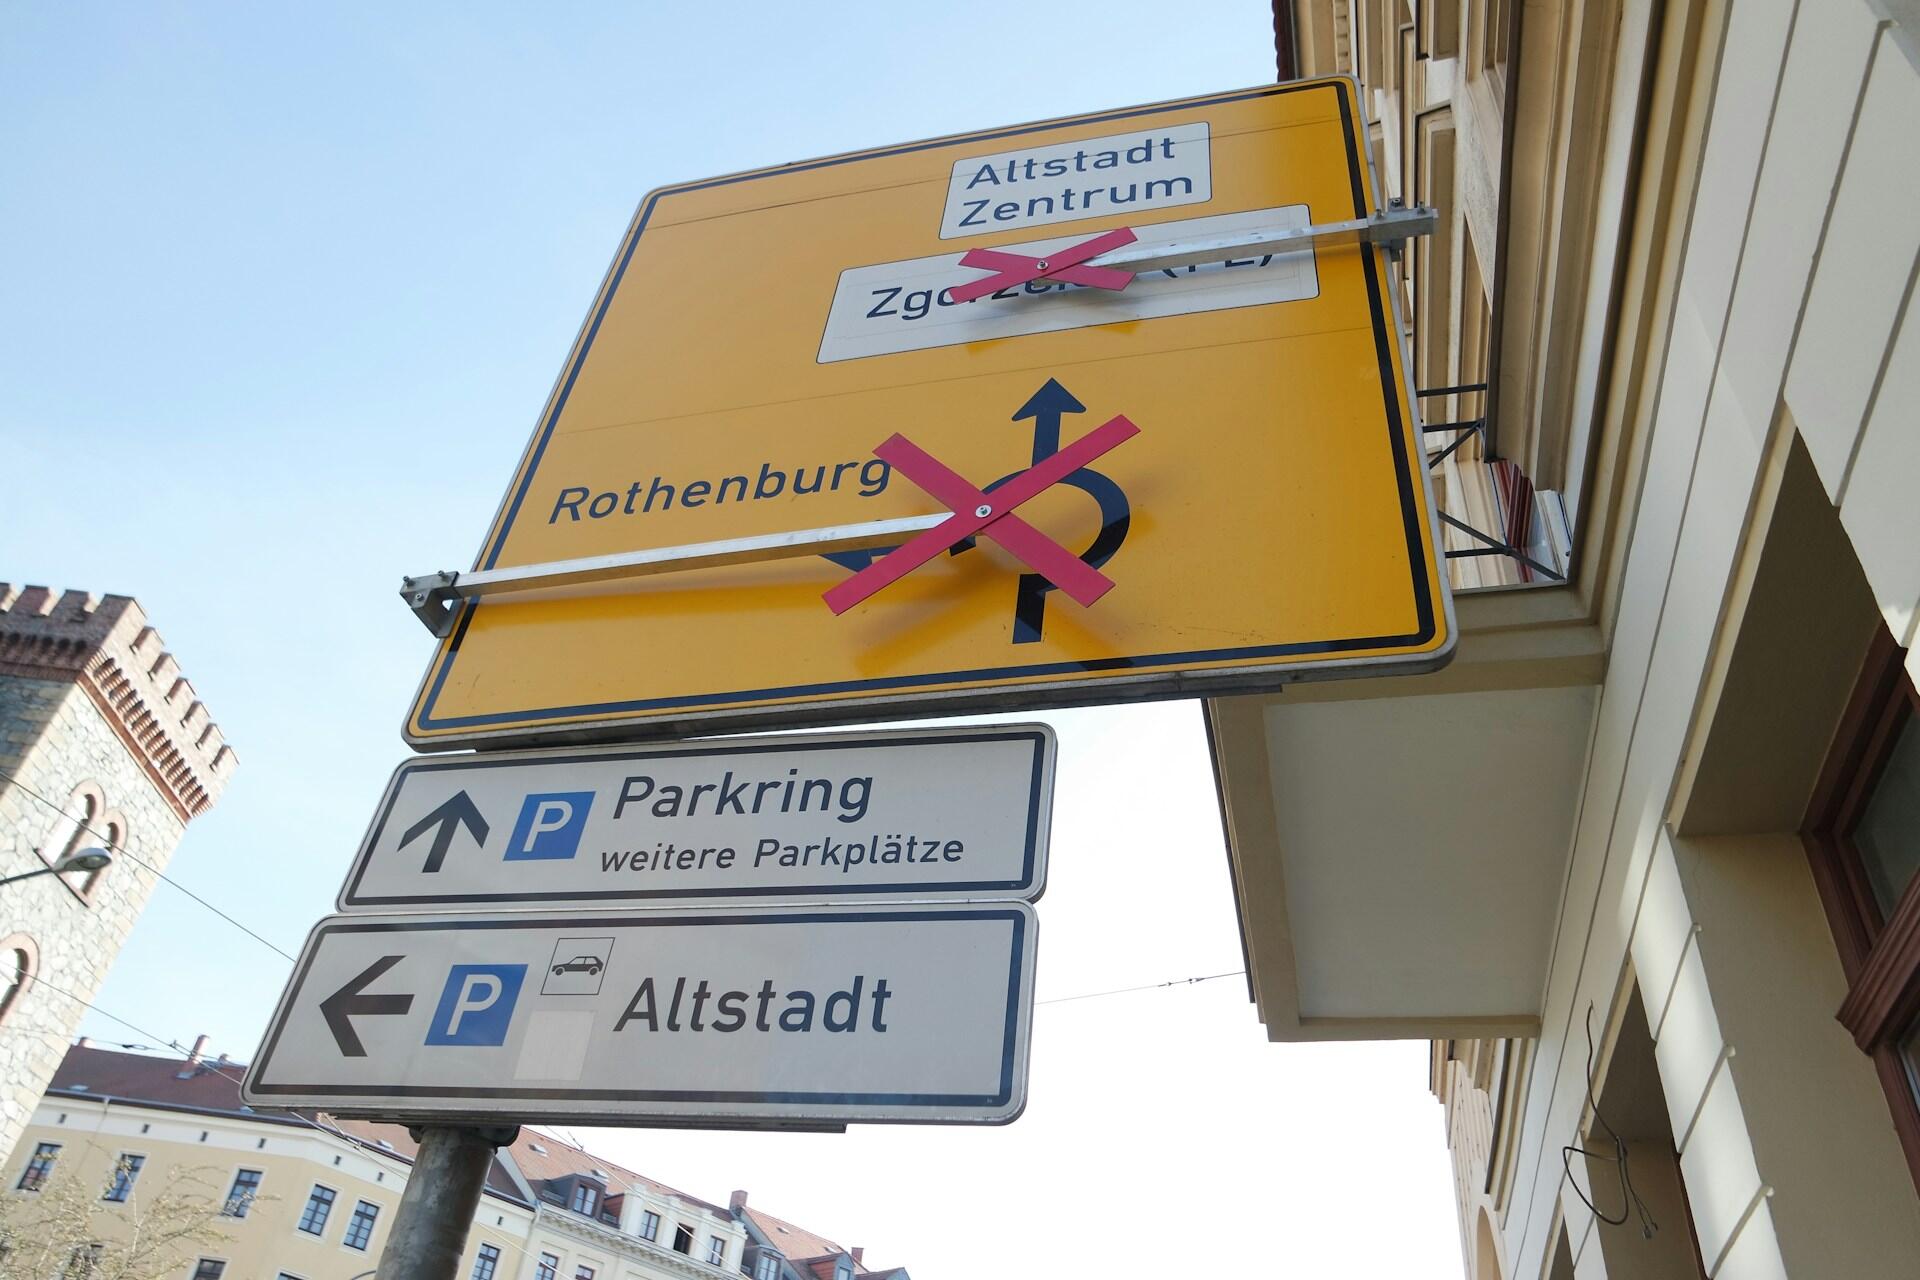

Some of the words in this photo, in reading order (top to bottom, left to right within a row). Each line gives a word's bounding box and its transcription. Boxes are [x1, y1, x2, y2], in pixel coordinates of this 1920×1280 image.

[966, 138, 1176, 190] Altstadt
[958, 177, 1193, 228] Zentrum
[548, 458, 892, 525] Rothenburg
[612, 768, 873, 824] Parkring
[522, 800, 573, 852] P
[601, 844, 736, 873] weitere
[753, 833, 964, 874] Parkplätze
[446, 974, 503, 1036] P
[612, 974, 892, 1033] Altstadt
